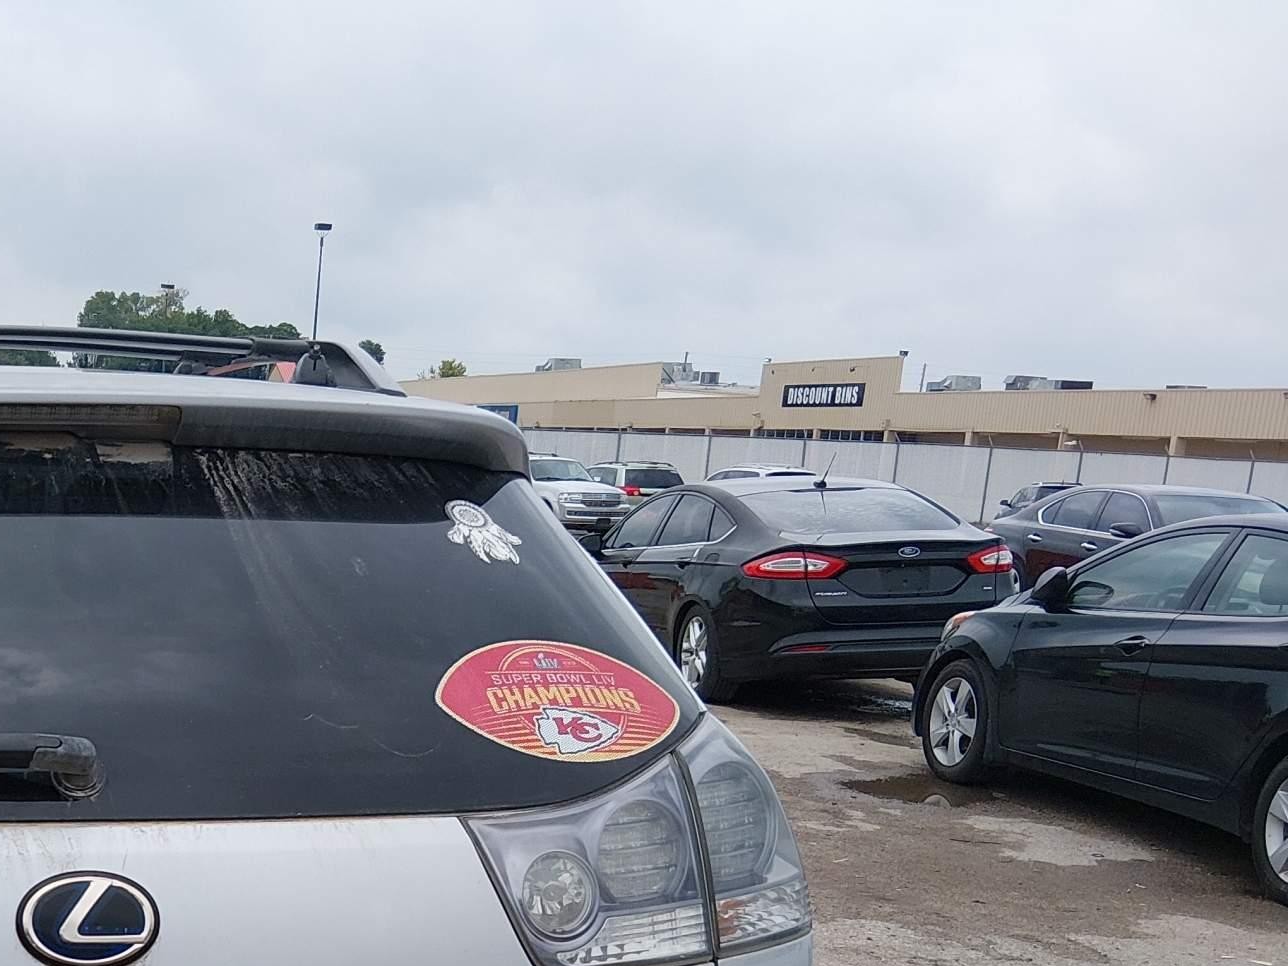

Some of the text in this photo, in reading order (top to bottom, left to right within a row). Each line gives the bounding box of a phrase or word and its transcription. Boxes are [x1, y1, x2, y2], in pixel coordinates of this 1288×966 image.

[787, 386, 859, 404] DISCOUNT BINS
[491, 673, 615, 686] SUPER BOWL LIV
[486, 685, 642, 714] CHAMPIONS
[552, 716, 603, 743] KC
